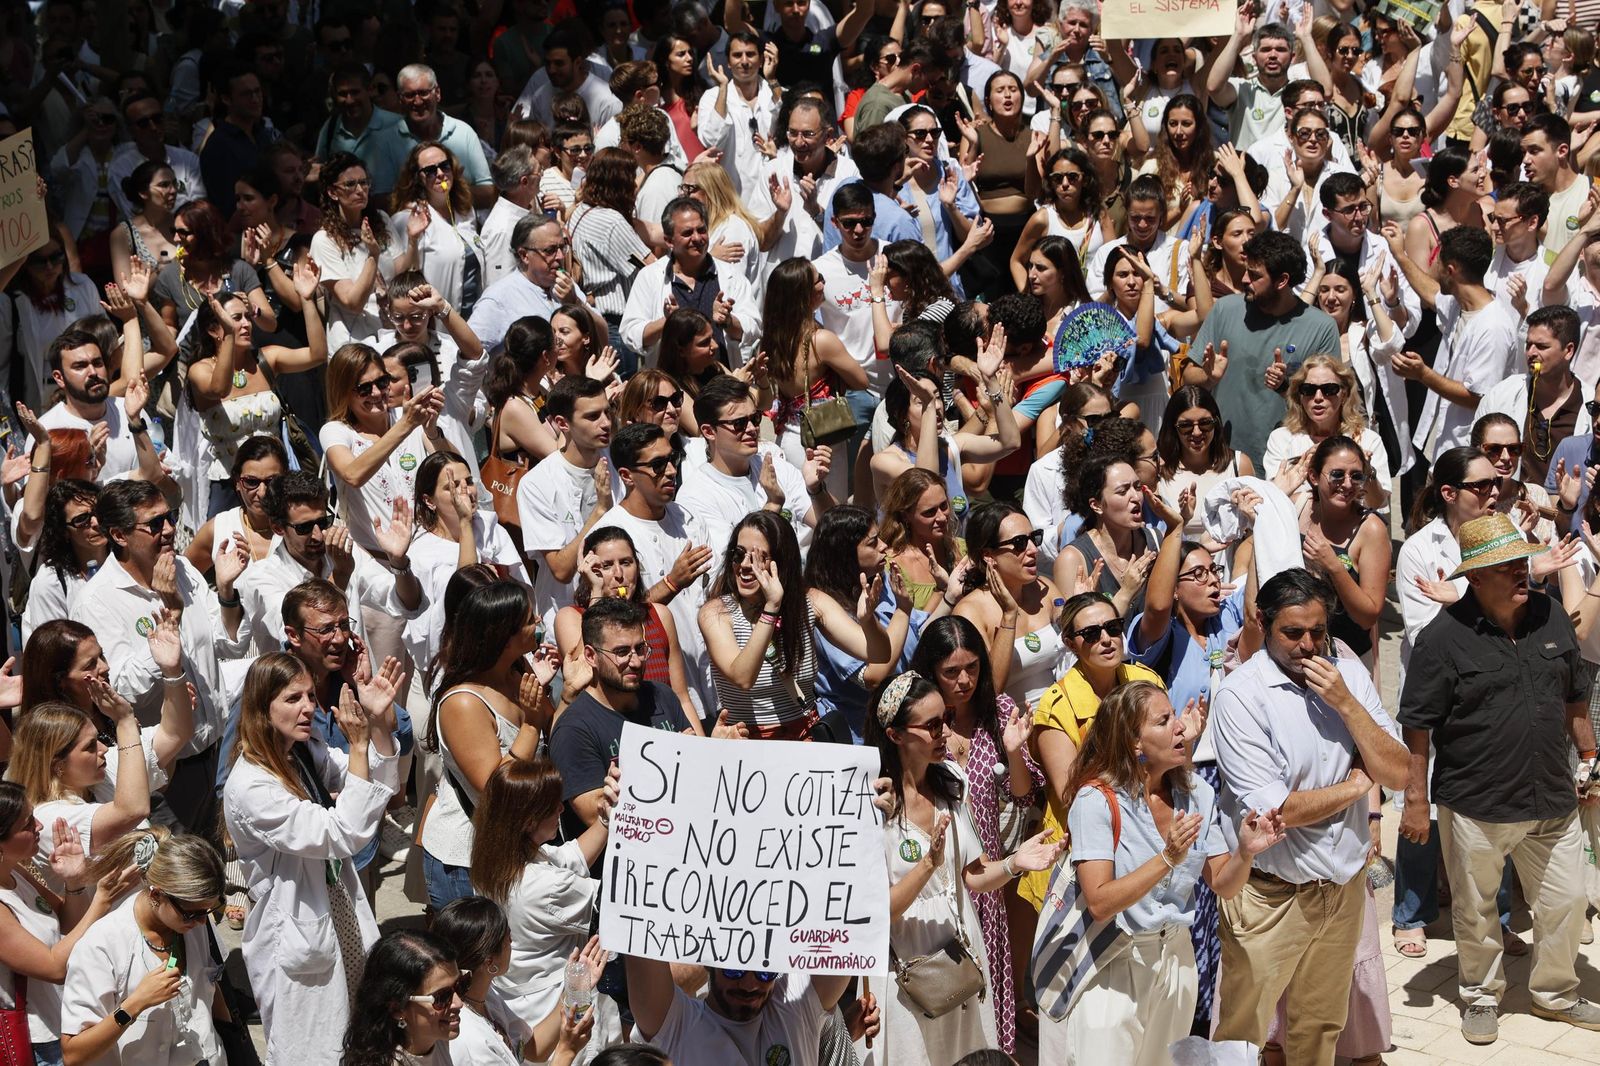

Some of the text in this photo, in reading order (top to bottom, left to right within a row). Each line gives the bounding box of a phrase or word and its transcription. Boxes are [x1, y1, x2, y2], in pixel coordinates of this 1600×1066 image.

[1130, 3, 1146, 13] EL
[490, 480, 514, 496] POM
[713, 759, 767, 816] NO
[614, 812, 654, 830] MALTRATO
[623, 803, 636, 813] STOP
[683, 819, 737, 868] NO
[825, 882, 871, 924] EL
[620, 915, 774, 968] TRABAJO!
